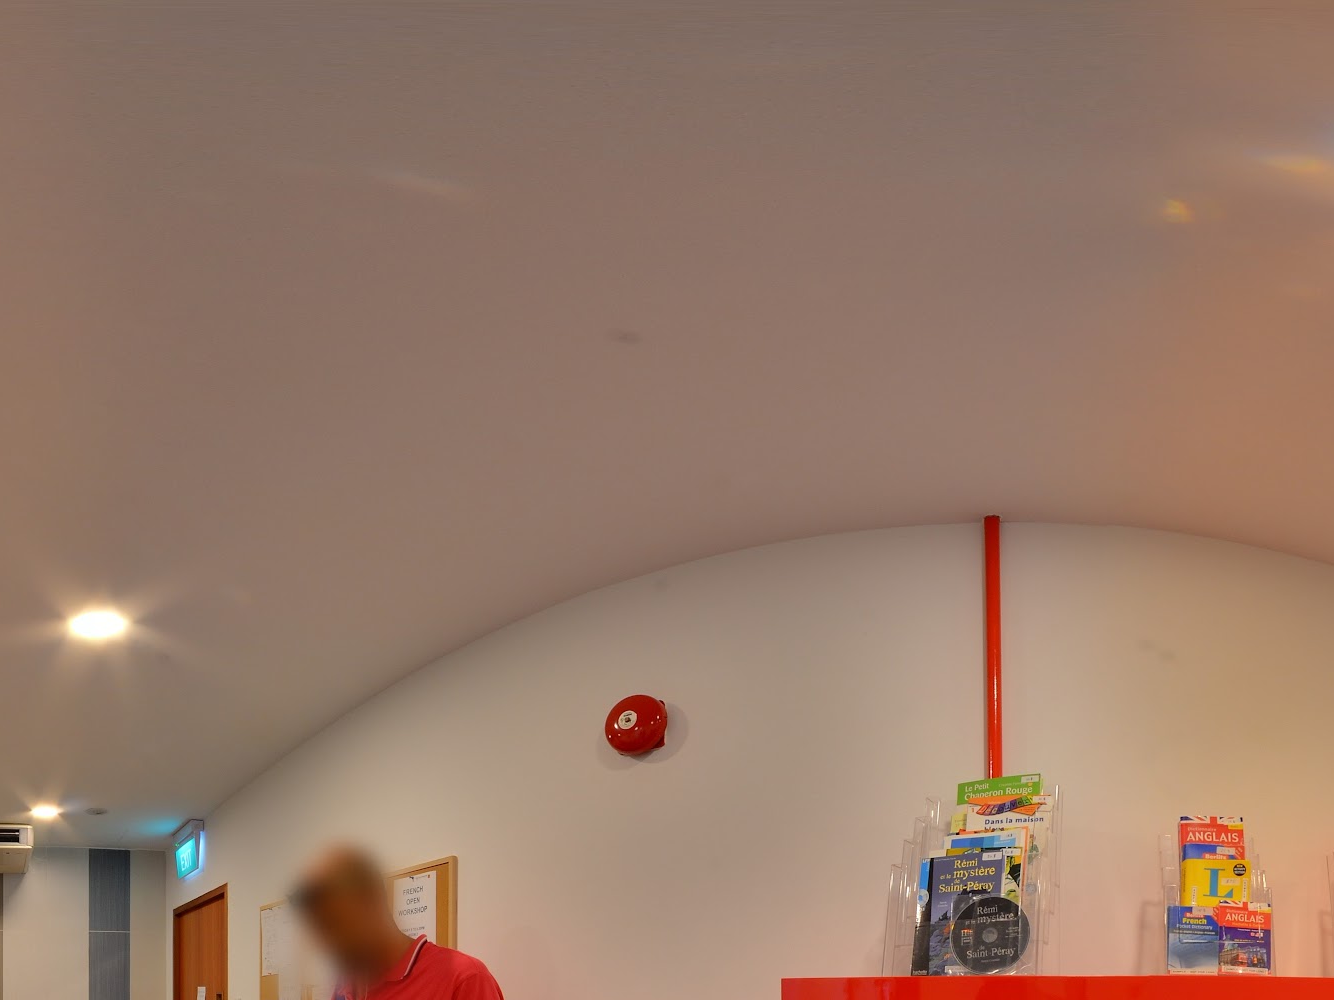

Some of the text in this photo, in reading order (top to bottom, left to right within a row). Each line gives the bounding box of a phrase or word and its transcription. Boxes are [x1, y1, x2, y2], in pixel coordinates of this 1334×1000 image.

[965, 784, 973, 792] Le
[974, 782, 989, 791] Petit
[1005, 786, 1033, 796] Rouge
[1186, 832, 1239, 843] ANGLAIS
[180, 848, 192, 871] EXIT
[954, 859, 978, 869] Rémi
[953, 866, 996, 879] mystère
[402, 886, 424, 896] FRENCH
[938, 881, 995, 893] Saint-Péray
[405, 897, 420, 905] OPEN
[398, 905, 428, 917] WORKSHOP
[976, 905, 998, 915] Rémi
[977, 912, 1015, 926] mystère
[1182, 917, 1207, 925] French
[1225, 913, 1265, 923] ANGLAIS
[966, 947, 1016, 959] Saint-Péray
